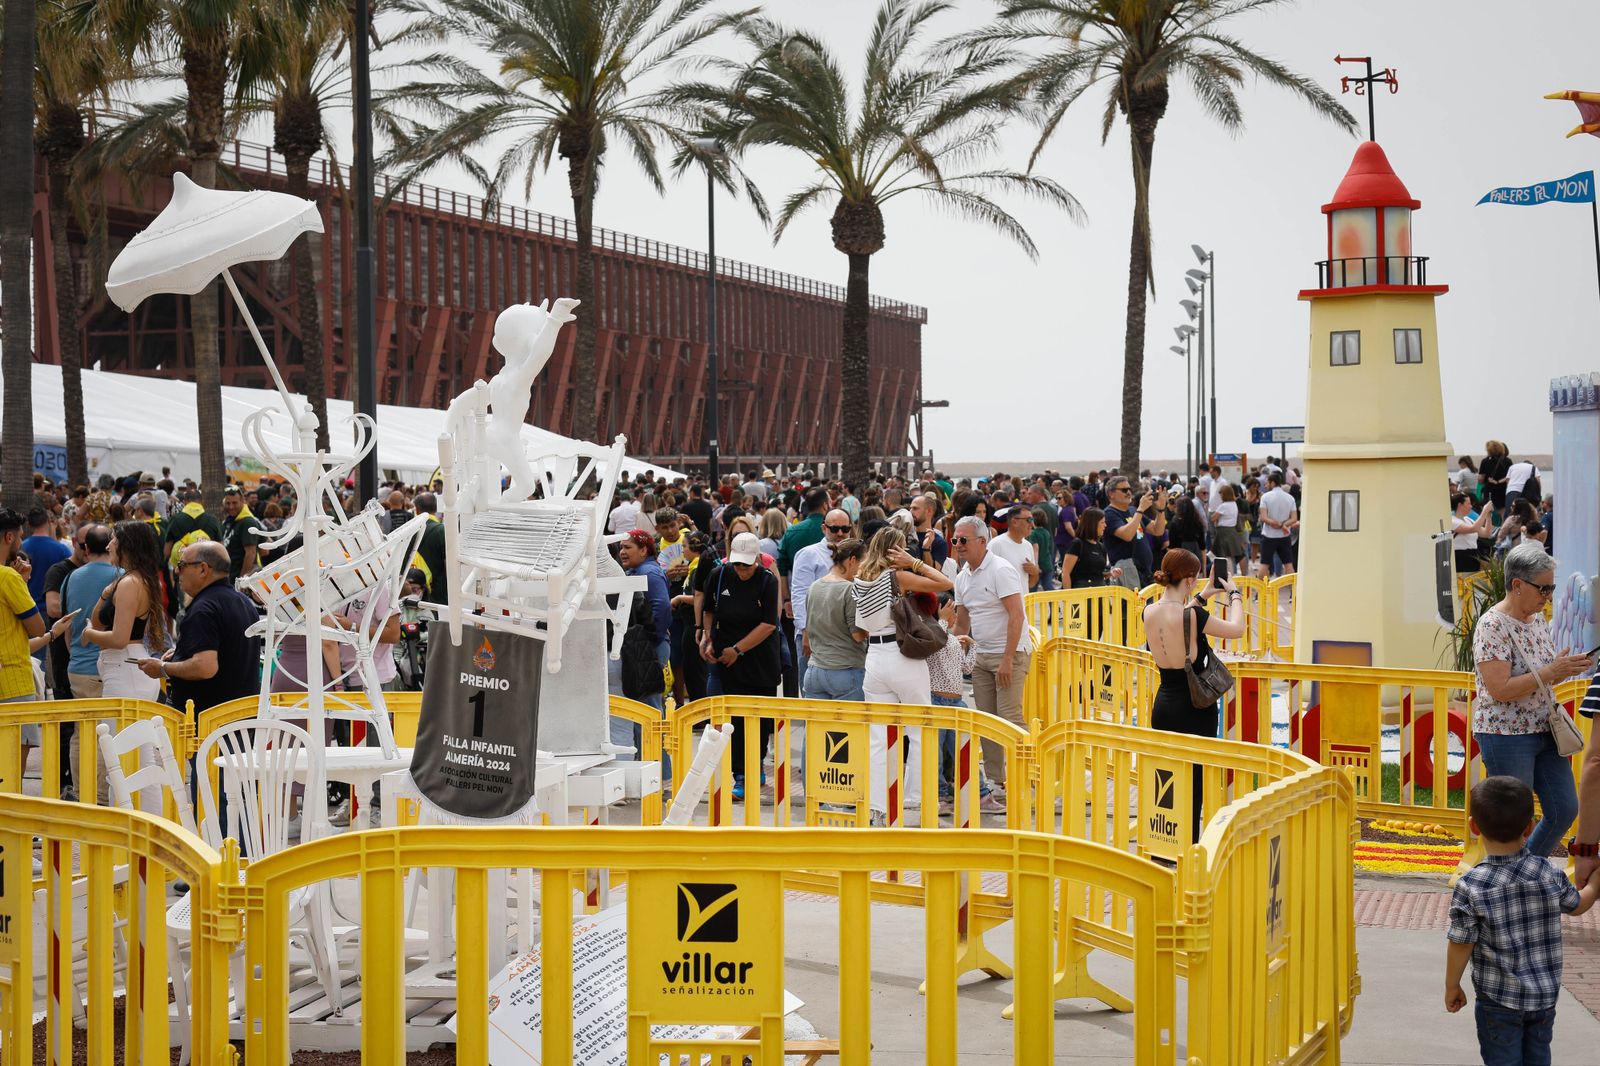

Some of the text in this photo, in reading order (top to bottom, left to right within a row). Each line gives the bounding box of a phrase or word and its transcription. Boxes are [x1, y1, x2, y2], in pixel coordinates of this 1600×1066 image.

[1490, 189, 1530, 203] FALLERS
[1554, 178, 1589, 199] MON
[1069, 622, 1082, 630] villar
[460, 672, 510, 691] PREMIO
[1100, 689, 1114, 702] villar
[468, 690, 486, 738] 1
[443, 734, 517, 757] FALLA INFANTIL
[445, 751, 511, 772] ALMERÍA 2024
[478, 773, 513, 785] CULTURAL
[819, 767, 855, 786] villar
[472, 783, 486, 792] PEL
[486, 785, 504, 794] MON
[1149, 814, 1178, 837] villar
[573, 945, 604, 964] uebles
[662, 952, 754, 984] villar
[510, 989, 522, 998] de
[523, 1012, 541, 1026] Los
[573, 964, 612, 990] isitaban
[662, 985, 754, 996] señalización
[576, 1002, 596, 1016] San
[592, 1016, 604, 1025] la
[576, 1039, 587, 1047] el
[586, 1019, 615, 1041] fuego
[580, 1030, 613, 1055] quema
